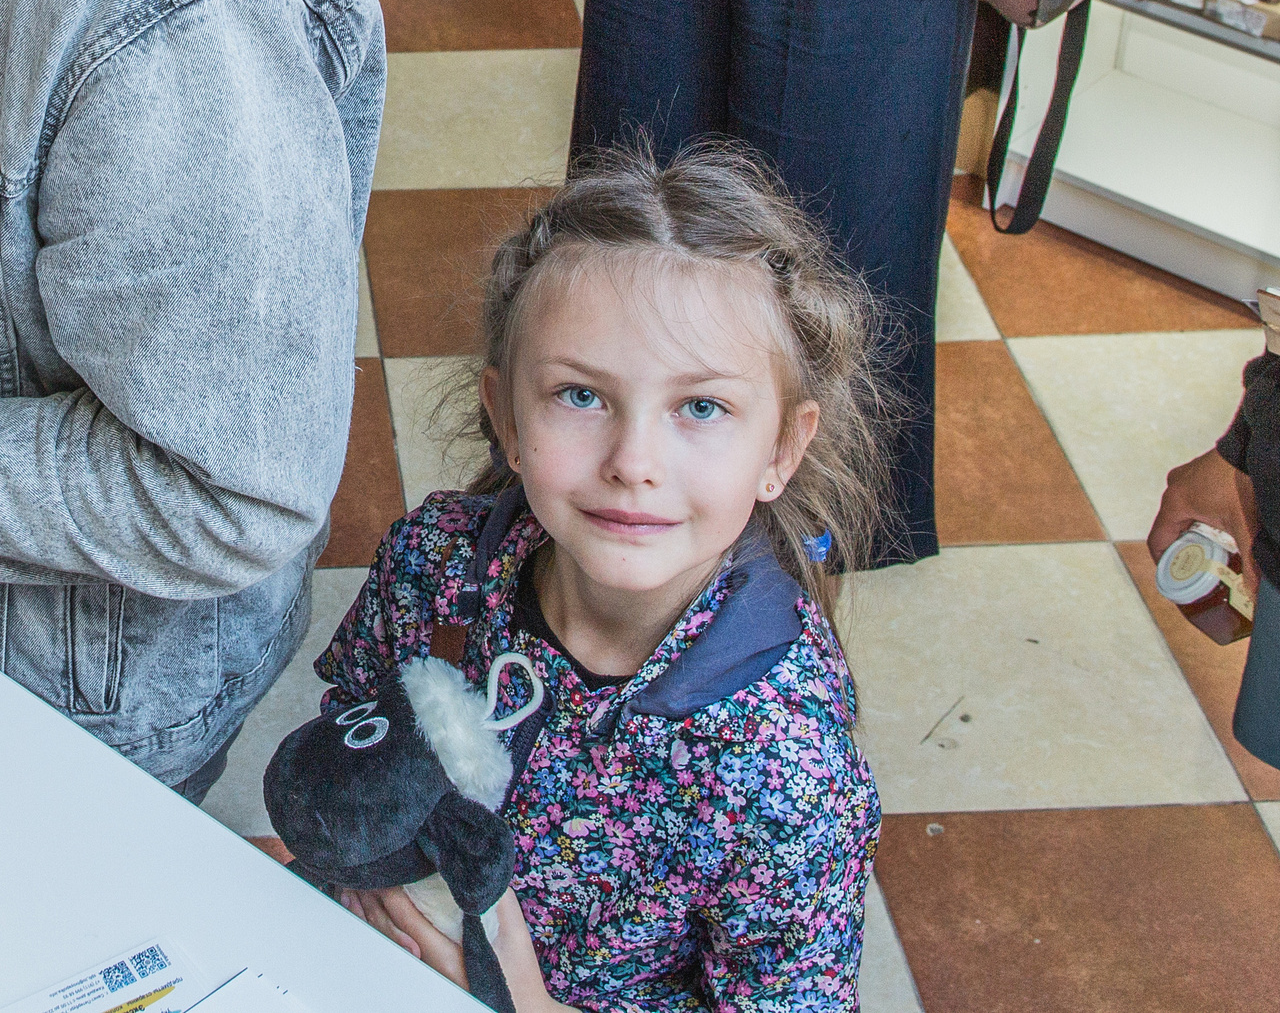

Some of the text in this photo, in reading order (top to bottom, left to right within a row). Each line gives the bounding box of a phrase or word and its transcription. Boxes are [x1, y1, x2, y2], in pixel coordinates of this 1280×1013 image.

[86, 985, 104, 996] Каждый
[153, 976, 183, 994] предметы
[126, 991, 152, 1005] старины
